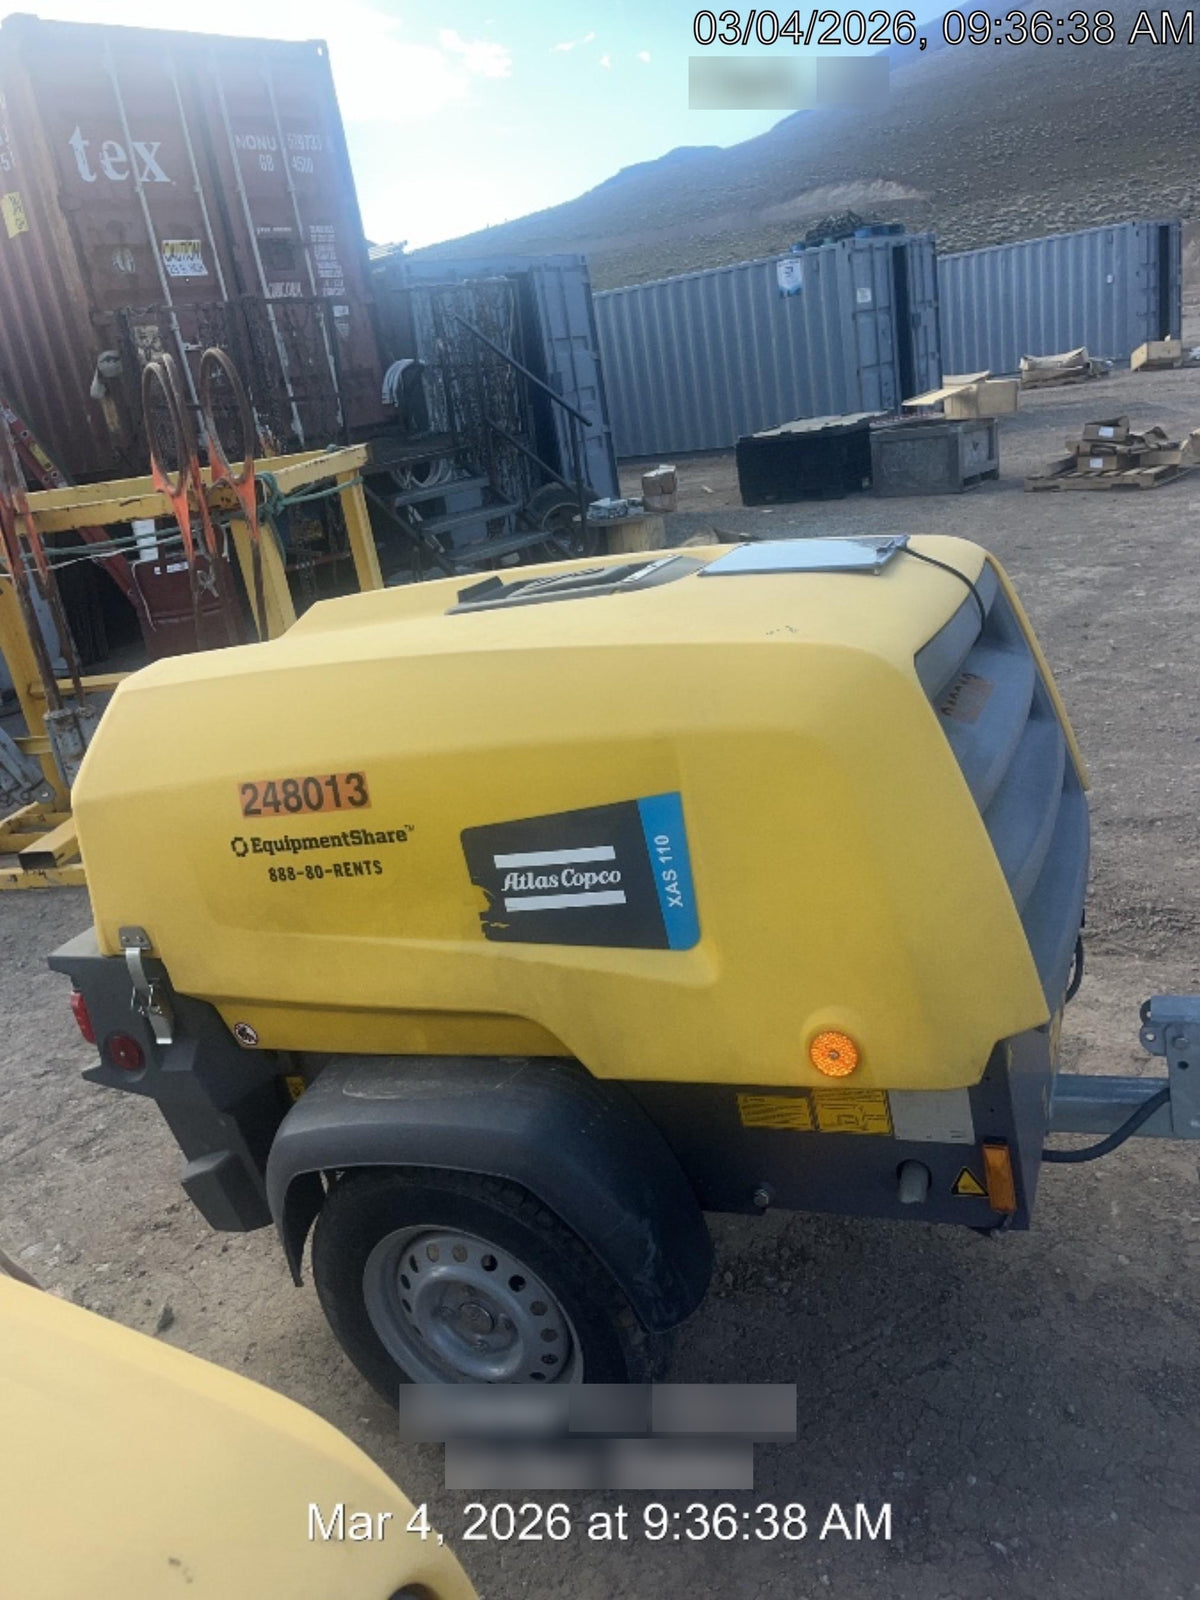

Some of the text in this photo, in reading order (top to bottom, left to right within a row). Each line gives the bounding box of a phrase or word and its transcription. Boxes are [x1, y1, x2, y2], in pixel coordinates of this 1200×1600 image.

[68, 125, 171, 183] tex
[241, 773, 369, 816] 248013
[268, 859, 383, 883] 888-80-RENTS
[502, 868, 622, 891] Atlas Copco
[654, 834, 684, 908] XAS 110
